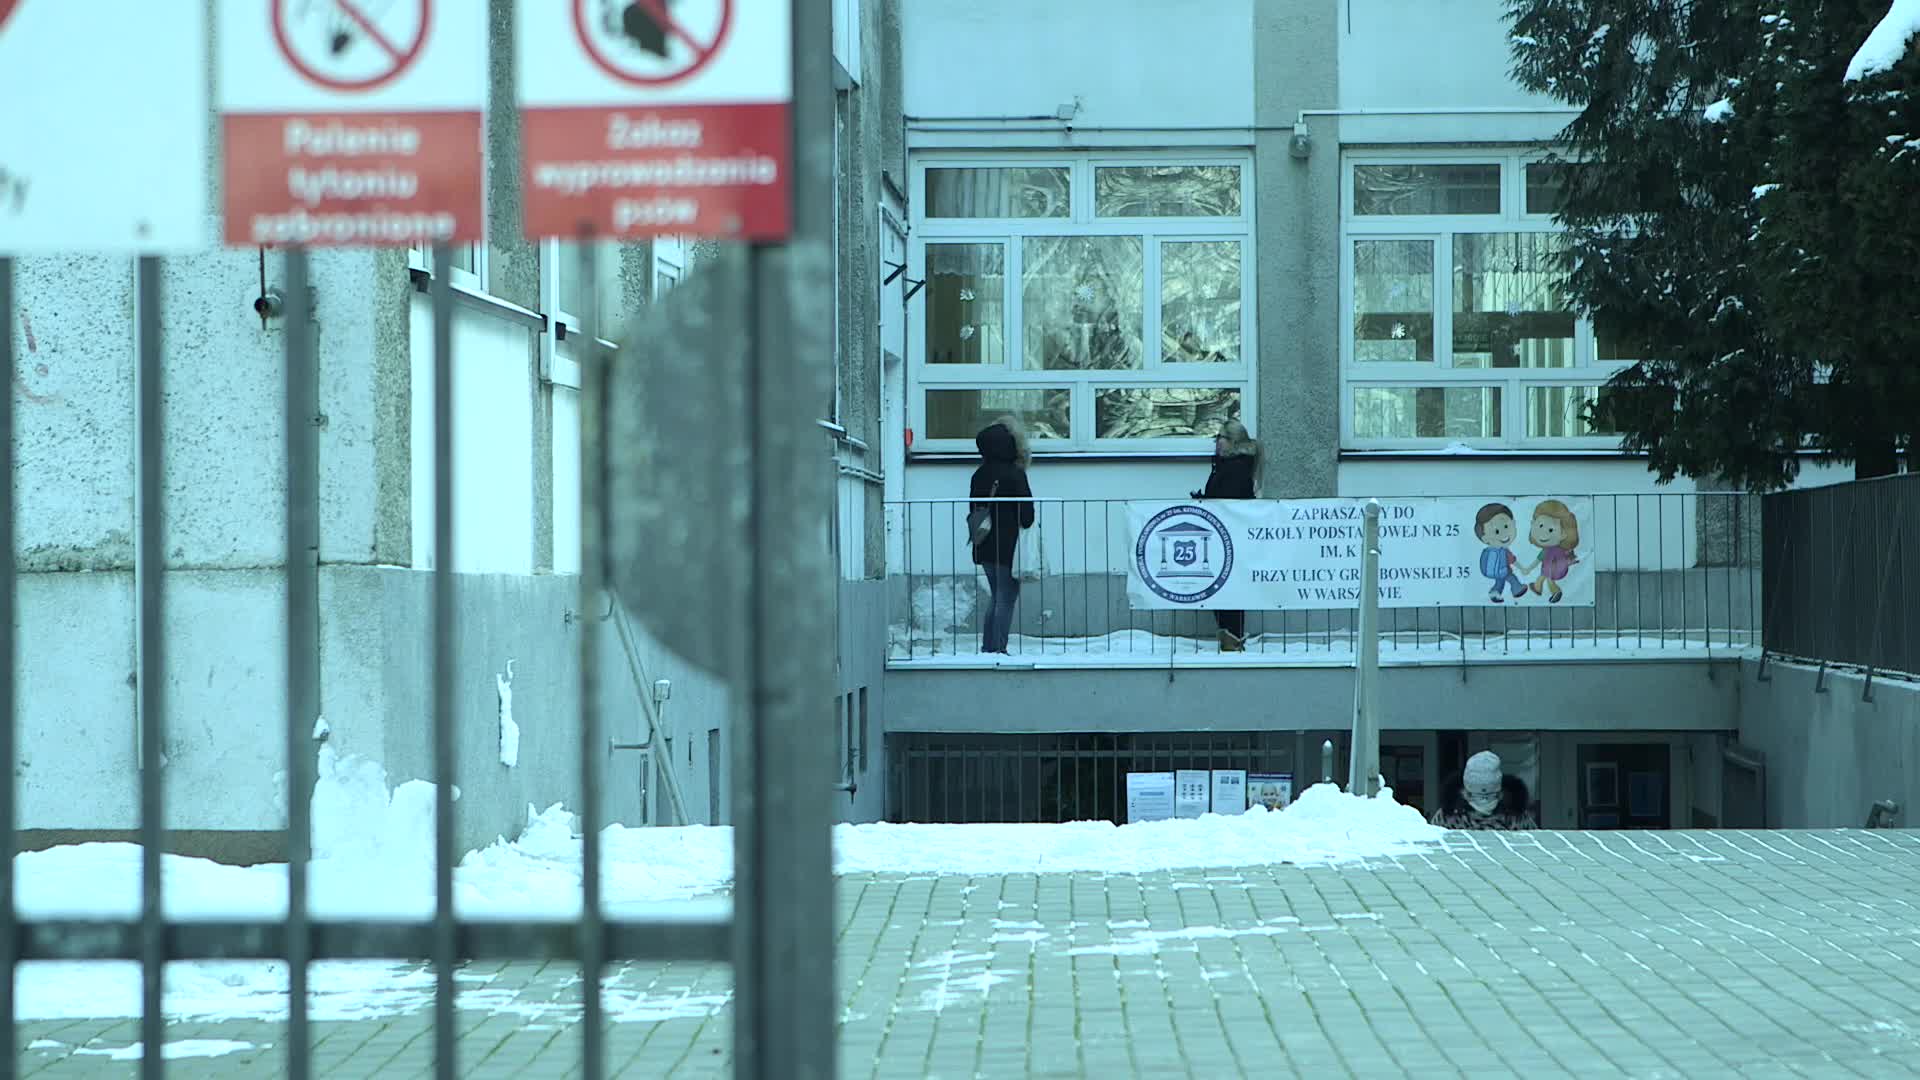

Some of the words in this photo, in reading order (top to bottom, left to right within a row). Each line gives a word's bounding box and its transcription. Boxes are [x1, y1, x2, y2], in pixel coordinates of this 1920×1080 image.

[285, 118, 421, 157] Palenie
[606, 112, 704, 149] Zakaz
[289, 164, 418, 207] tytoniu
[253, 211, 456, 242] zabronione
[1291, 505, 1391, 521] ZAPRASZAY
[1394, 505, 1415, 520] DO
[1309, 524, 1418, 540] PODSTAOWEJ
[1422, 524, 1442, 537] NR
[1446, 523, 1460, 537] 25
[1175, 546, 1194, 561] 25
[1320, 544, 1342, 559] IM.
[1252, 569, 1288, 583] PRZY
[1293, 568, 1336, 582] ULICY
[1339, 566, 1453, 582] GRBOWSKIEJ
[1456, 565, 1471, 579] 35
[1297, 587, 1312, 601] W
[1314, 586, 1402, 601] WARSZWIE
